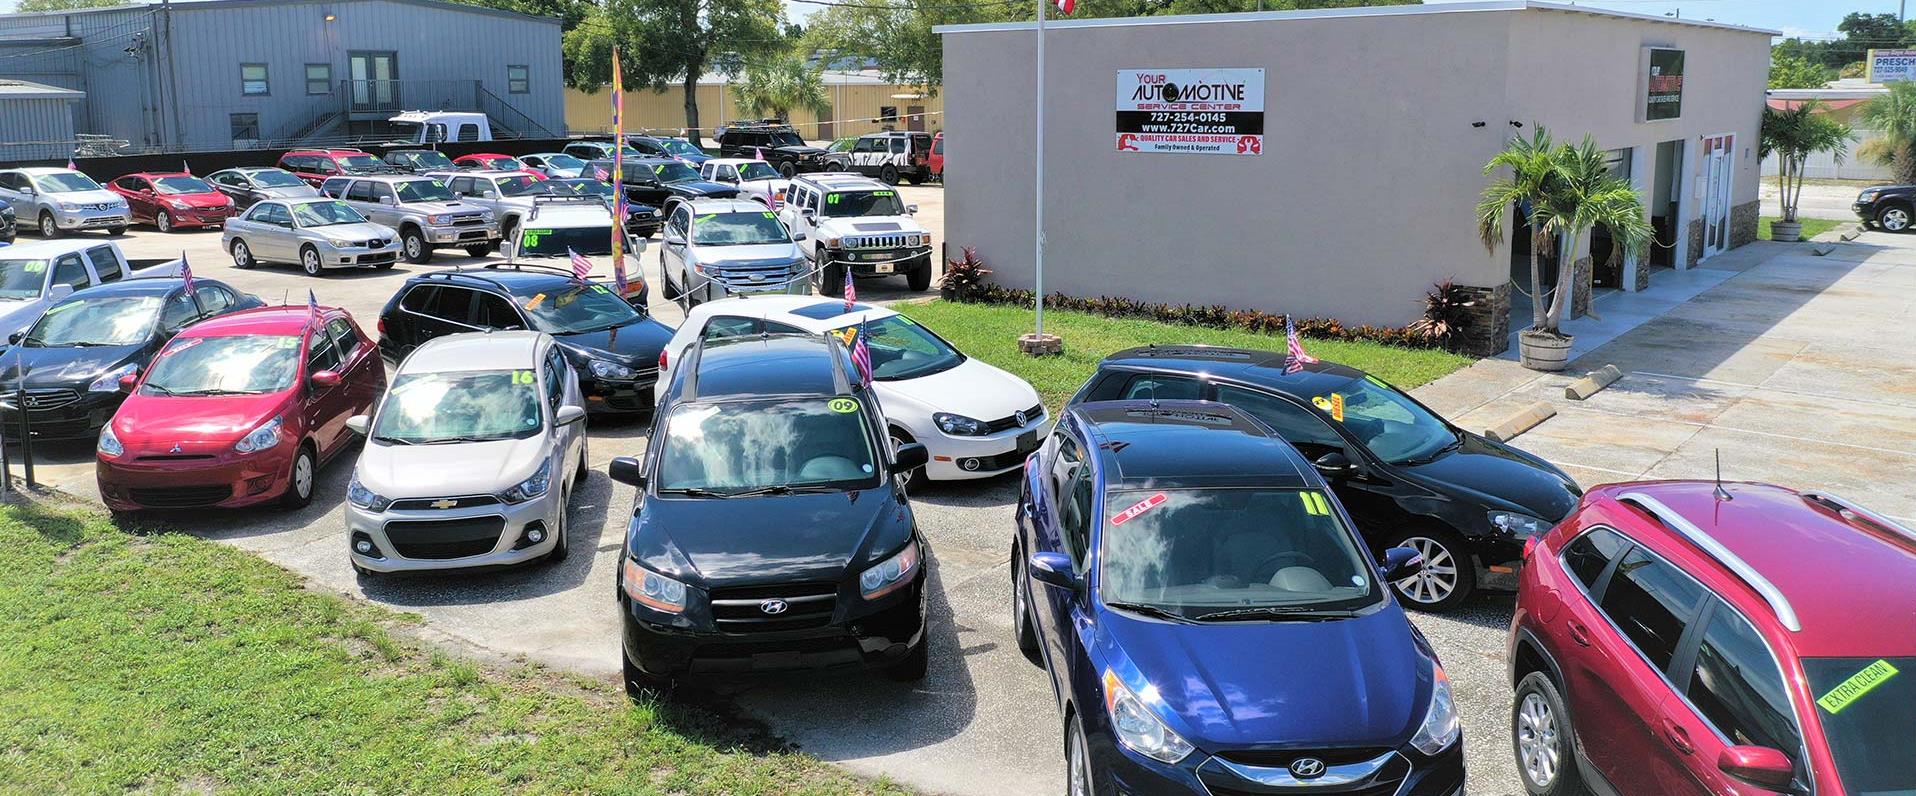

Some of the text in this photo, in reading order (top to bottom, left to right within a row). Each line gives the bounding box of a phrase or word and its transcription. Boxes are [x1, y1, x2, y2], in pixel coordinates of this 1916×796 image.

[1875, 58, 1916, 66] PRESCH
[1136, 73, 1166, 84] YOUR
[1131, 83, 1245, 103] AUTOMOTIVE
[1150, 112, 1226, 122] 727-254-0145
[1141, 123, 1236, 133] www.727Car.com
[1178, 135, 1197, 143] SALES
[1154, 143, 1172, 152] Family
[827, 194, 840, 204] 07
[523, 235, 539, 248] 08
[276, 337, 298, 348] 15
[512, 370, 534, 384] 16
[834, 401, 853, 410] 09
[1126, 499, 1153, 517] SALE
[1299, 491, 1330, 516] 11
[1824, 662, 1889, 708] EXTRA CLEAN
